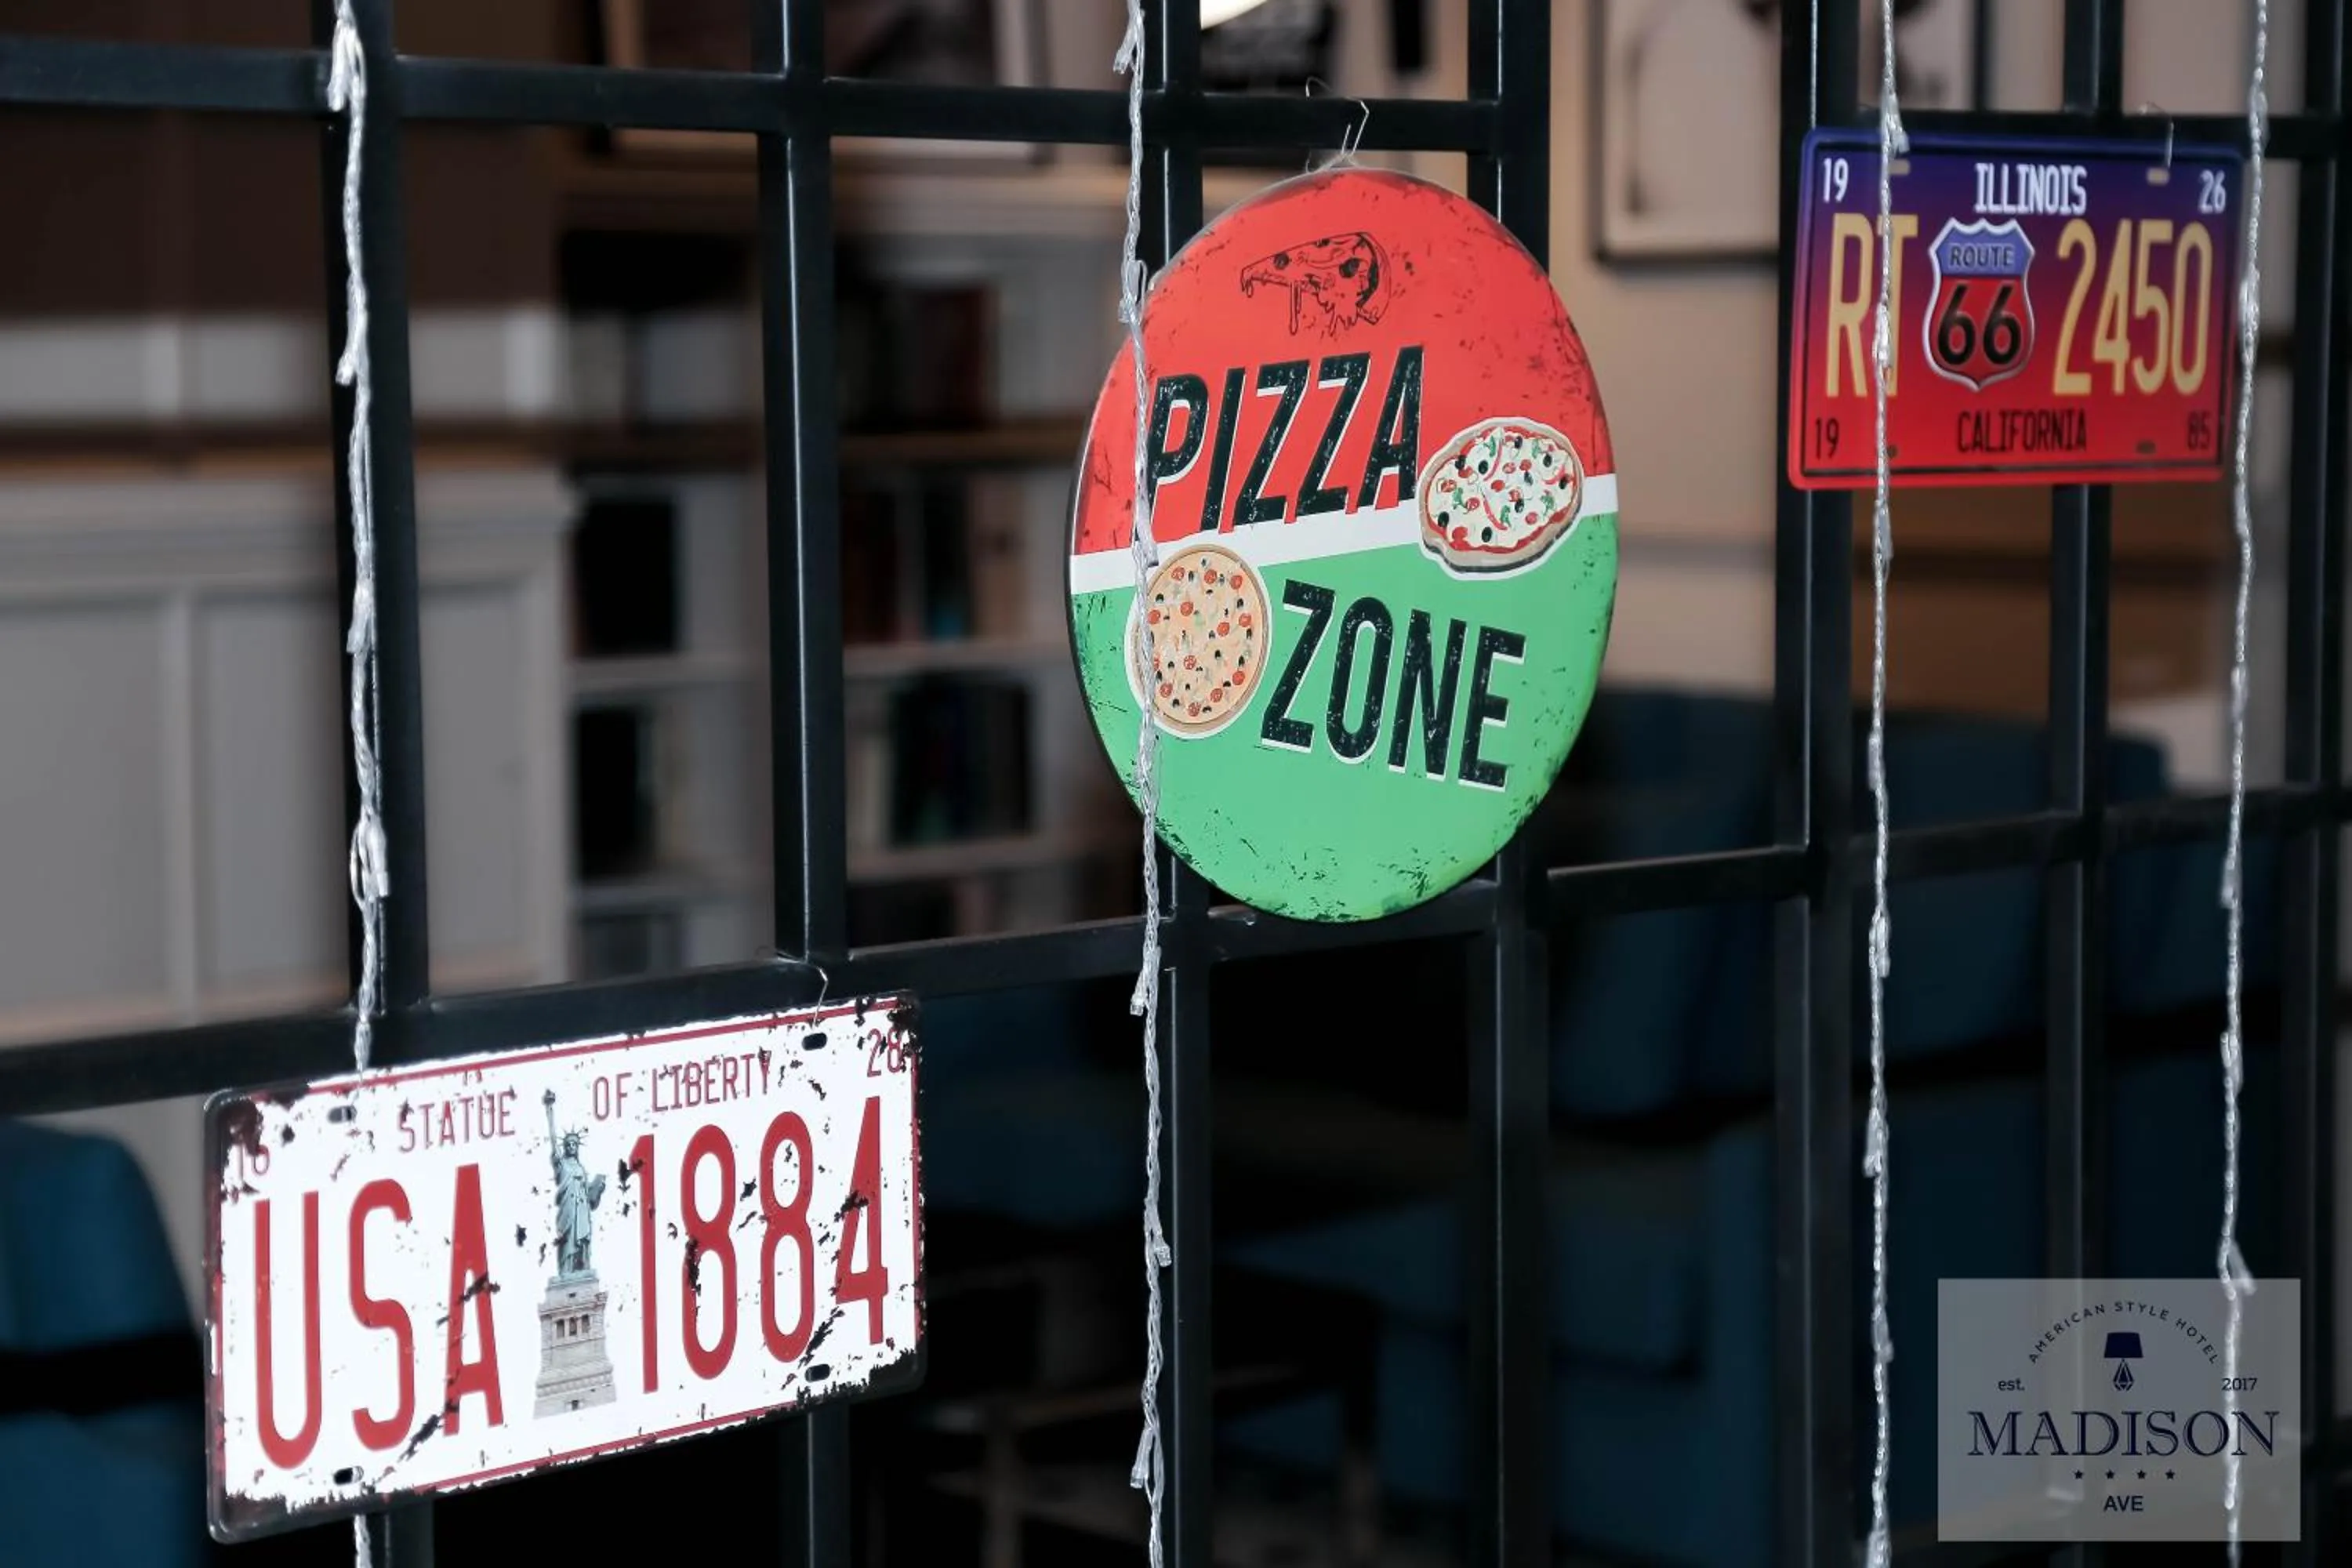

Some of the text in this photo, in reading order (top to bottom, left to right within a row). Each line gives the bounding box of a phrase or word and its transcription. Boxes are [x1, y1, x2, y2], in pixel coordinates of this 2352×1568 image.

[1822, 158, 1848, 203] 19
[1974, 162, 2087, 216] ILLINOIS
[2198, 169, 2227, 213] 26
[1947, 241, 2015, 270] ROUTE
[1826, 212, 1918, 398] RT
[1936, 282, 2022, 367] 66
[2054, 218, 2212, 397] 2450
[1135, 345, 1424, 541] PIZZA
[1815, 417, 1839, 459] 19
[1957, 408, 2087, 453] CALIFORNIA
[1259, 578, 1526, 792] ZONE
[866, 1026, 903, 1078] 28
[398, 1049, 772, 1152] STATUE OF LIBERTY
[253, 1094, 889, 1470] USA 1884
